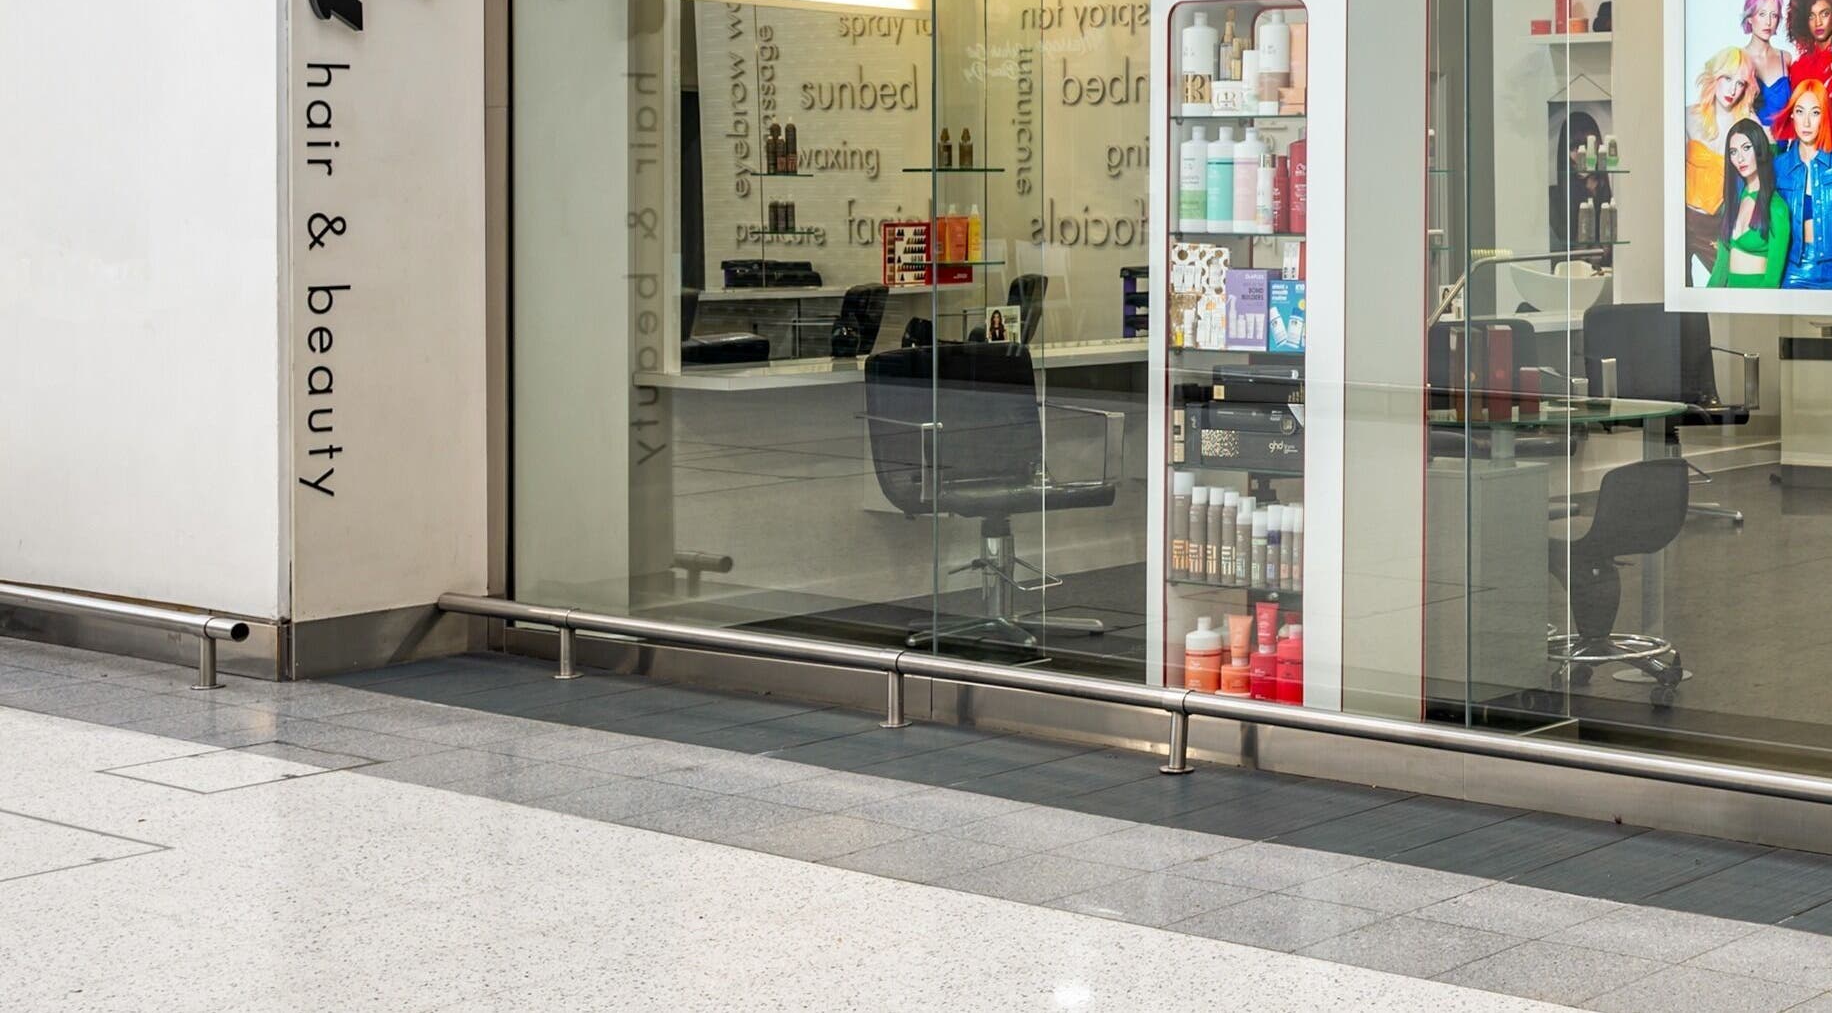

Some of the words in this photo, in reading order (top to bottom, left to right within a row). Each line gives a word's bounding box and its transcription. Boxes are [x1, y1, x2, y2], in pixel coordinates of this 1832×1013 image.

[305, 61, 351, 177] hair
[801, 63, 919, 111] sunbed
[307, 212, 347, 252] &
[298, 283, 351, 498] beauty
